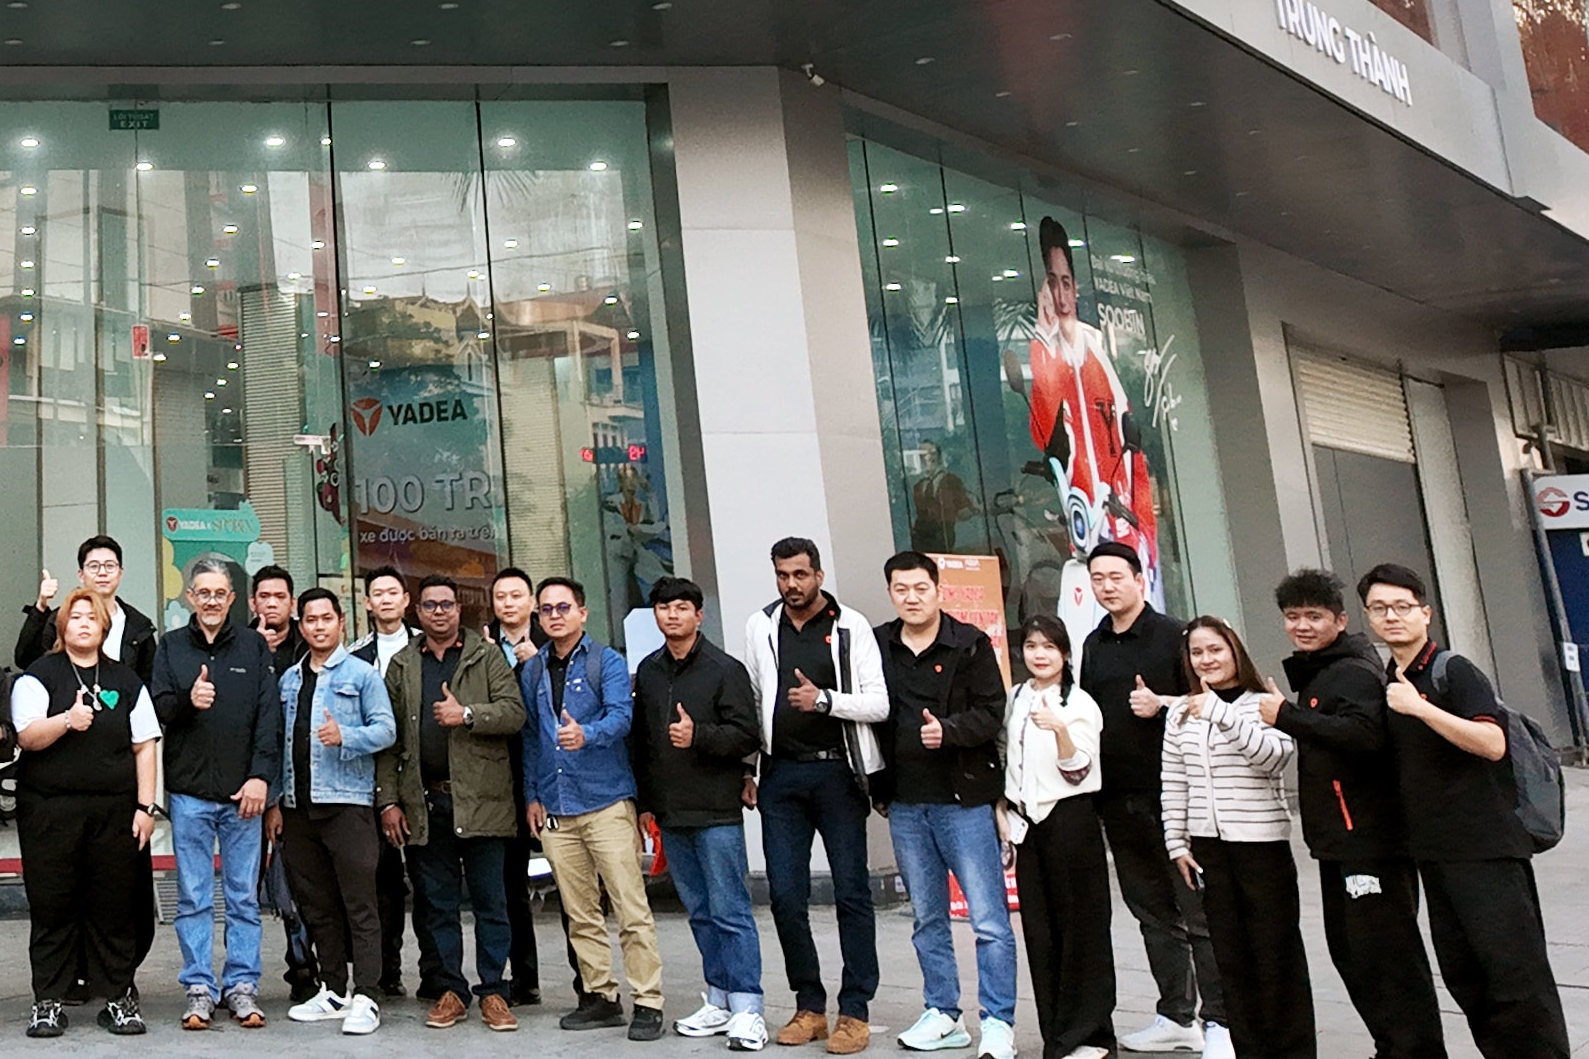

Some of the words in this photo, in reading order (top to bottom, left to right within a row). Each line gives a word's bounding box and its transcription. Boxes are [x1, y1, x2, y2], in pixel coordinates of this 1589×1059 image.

[1345, 31, 1413, 108] THÀNH
[1097, 302, 1146, 336] SOOBIN
[387, 398, 469, 427] YADEA
[354, 473, 426, 516] 100
[360, 531, 377, 544] xe
[379, 526, 416, 545] được
[419, 524, 447, 542] bán
